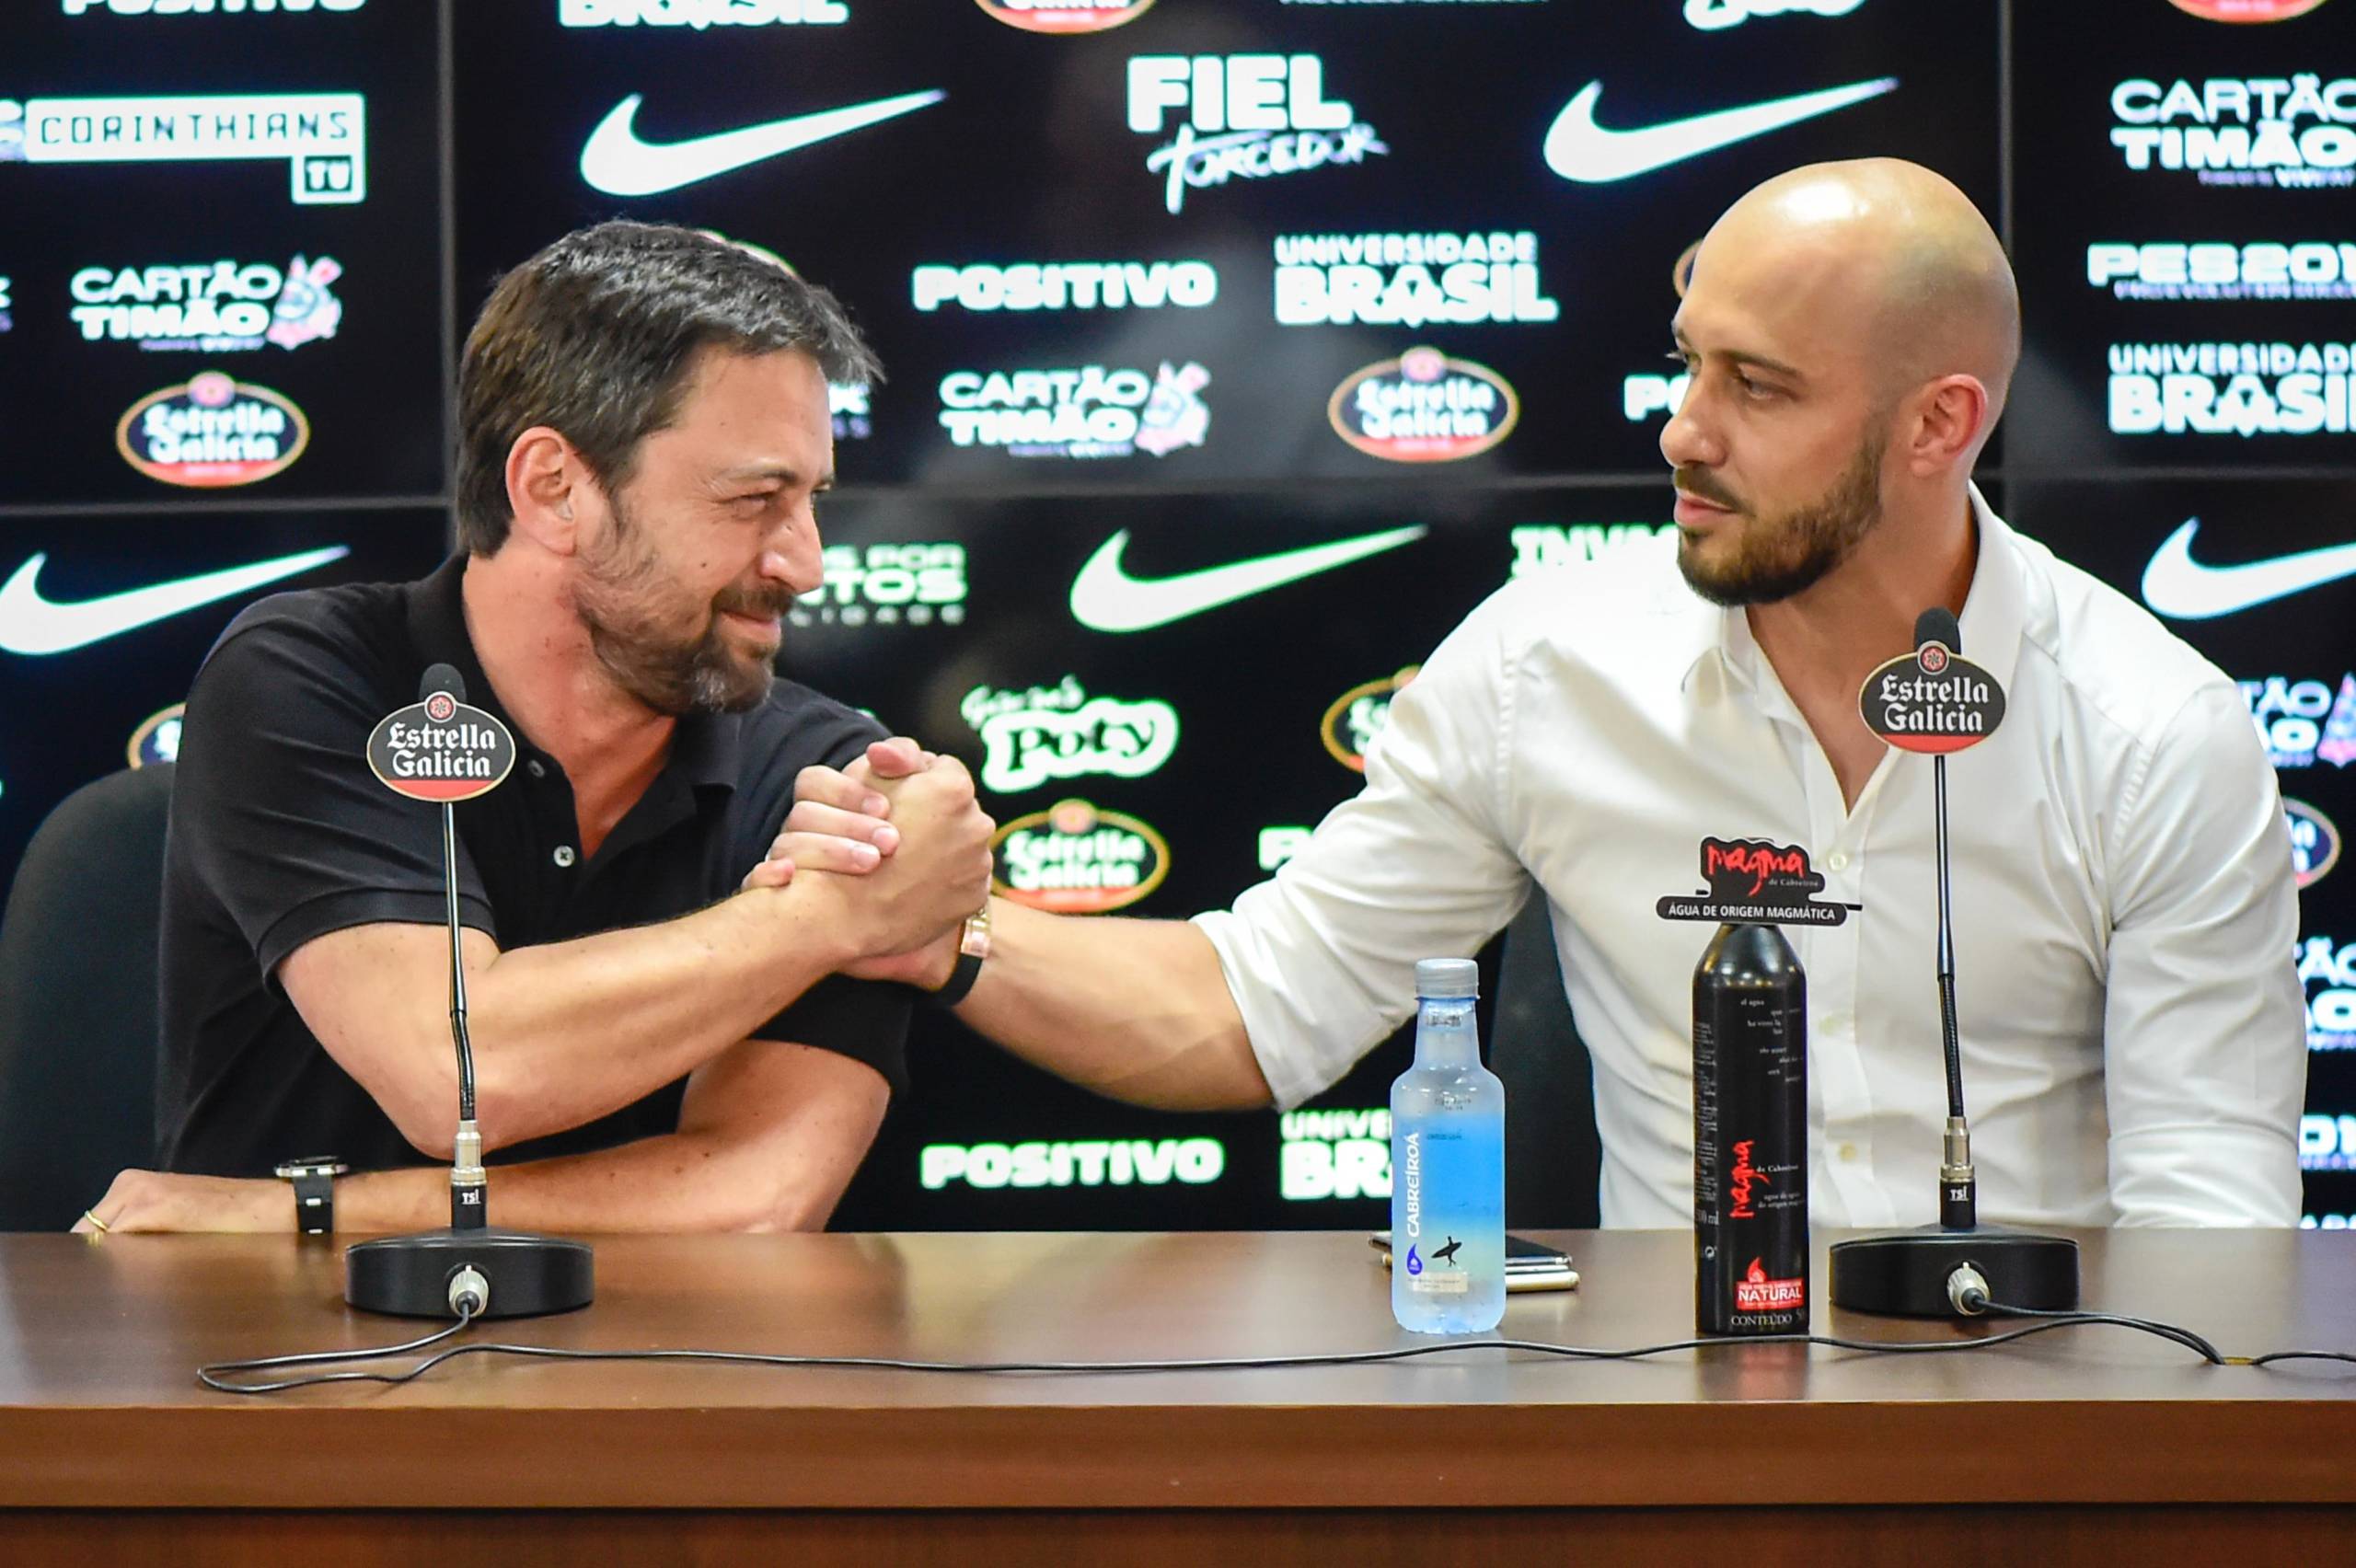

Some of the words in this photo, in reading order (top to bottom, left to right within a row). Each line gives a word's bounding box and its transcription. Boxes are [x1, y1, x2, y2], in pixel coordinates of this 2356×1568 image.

[1127, 54, 1353, 132] FIEL
[40, 110, 349, 144] CORINTHIANS
[2110, 121, 2356, 169] TIMÃO
[1275, 232, 1538, 266] UNIVERSIDADE
[71, 261, 283, 302] CARTÃO
[913, 260, 1218, 311] POSITIVO
[1274, 263, 1558, 327] BRASIL
[71, 299, 271, 340] TIMÃO
[939, 365, 1150, 408] CARTÃO
[2108, 373, 2356, 437] BRASI
[939, 405, 1140, 446] TIMÃO
[1878, 674, 1990, 703] Estrella
[387, 721, 497, 749] Estrella
[1885, 702, 1983, 732] Galicia
[393, 749, 491, 777] Galicia
[1669, 902, 1700, 917] ÁGUA
[1703, 905, 1717, 917] DE
[1720, 905, 1764, 917] ORIGEM
[1767, 905, 1836, 920] MAGMÁTICA
[921, 1138, 1224, 1189] POSITIVO
[1738, 1286, 1802, 1302] NATURAL
[1730, 1313, 1793, 1326] CONTEÚDO
